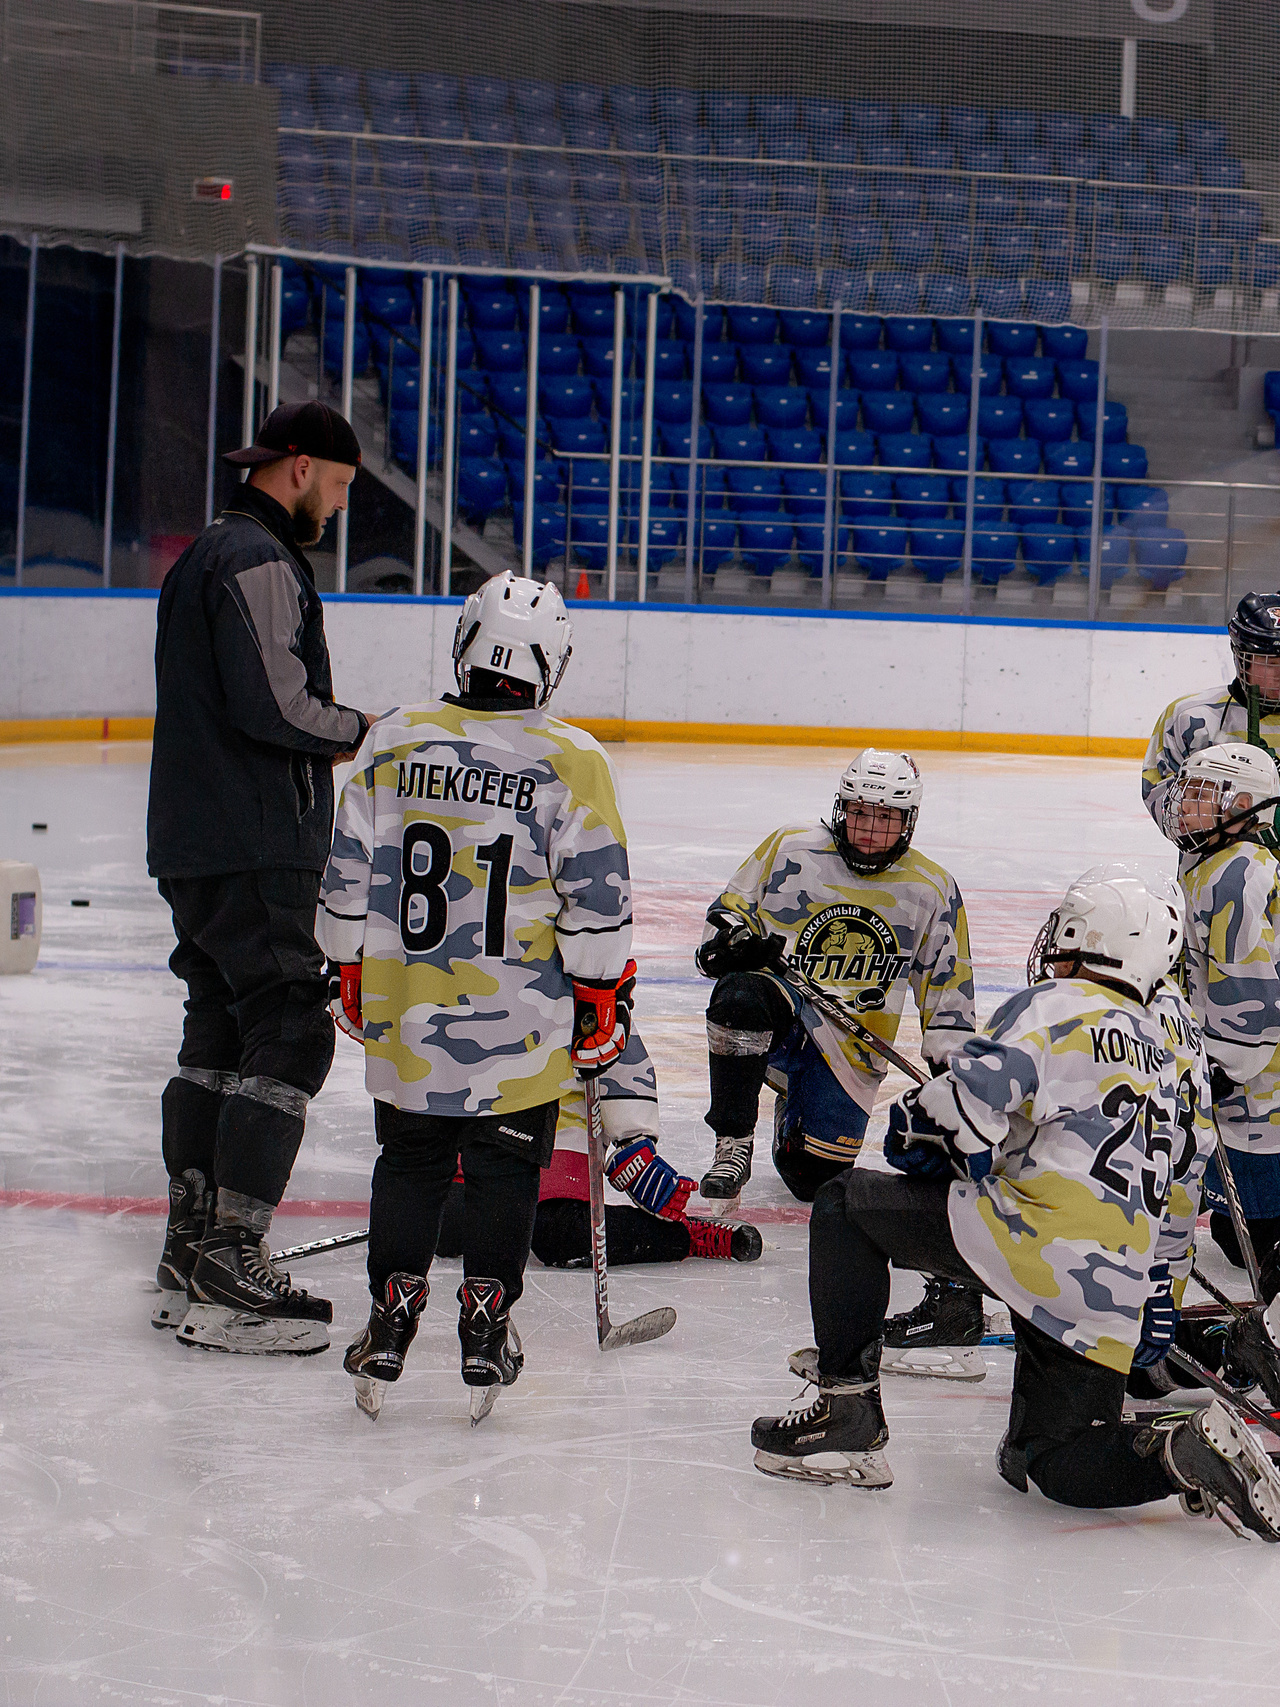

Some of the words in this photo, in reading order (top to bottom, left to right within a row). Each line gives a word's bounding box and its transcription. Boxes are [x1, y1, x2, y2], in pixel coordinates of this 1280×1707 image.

[490, 645, 513, 670] 81
[396, 762, 537, 812] АЛЕКСЕЕВ
[862, 782, 887, 791] CCM
[399, 820, 514, 957] 81
[800, 905, 862, 948] ХОККЕЙНЫЙ
[869, 915, 893, 945] КЛУБ
[787, 953, 912, 982] АТЛАНТ
[498, 1124, 534, 1143] BAUER
[1089, 1083, 1172, 1219] 25
